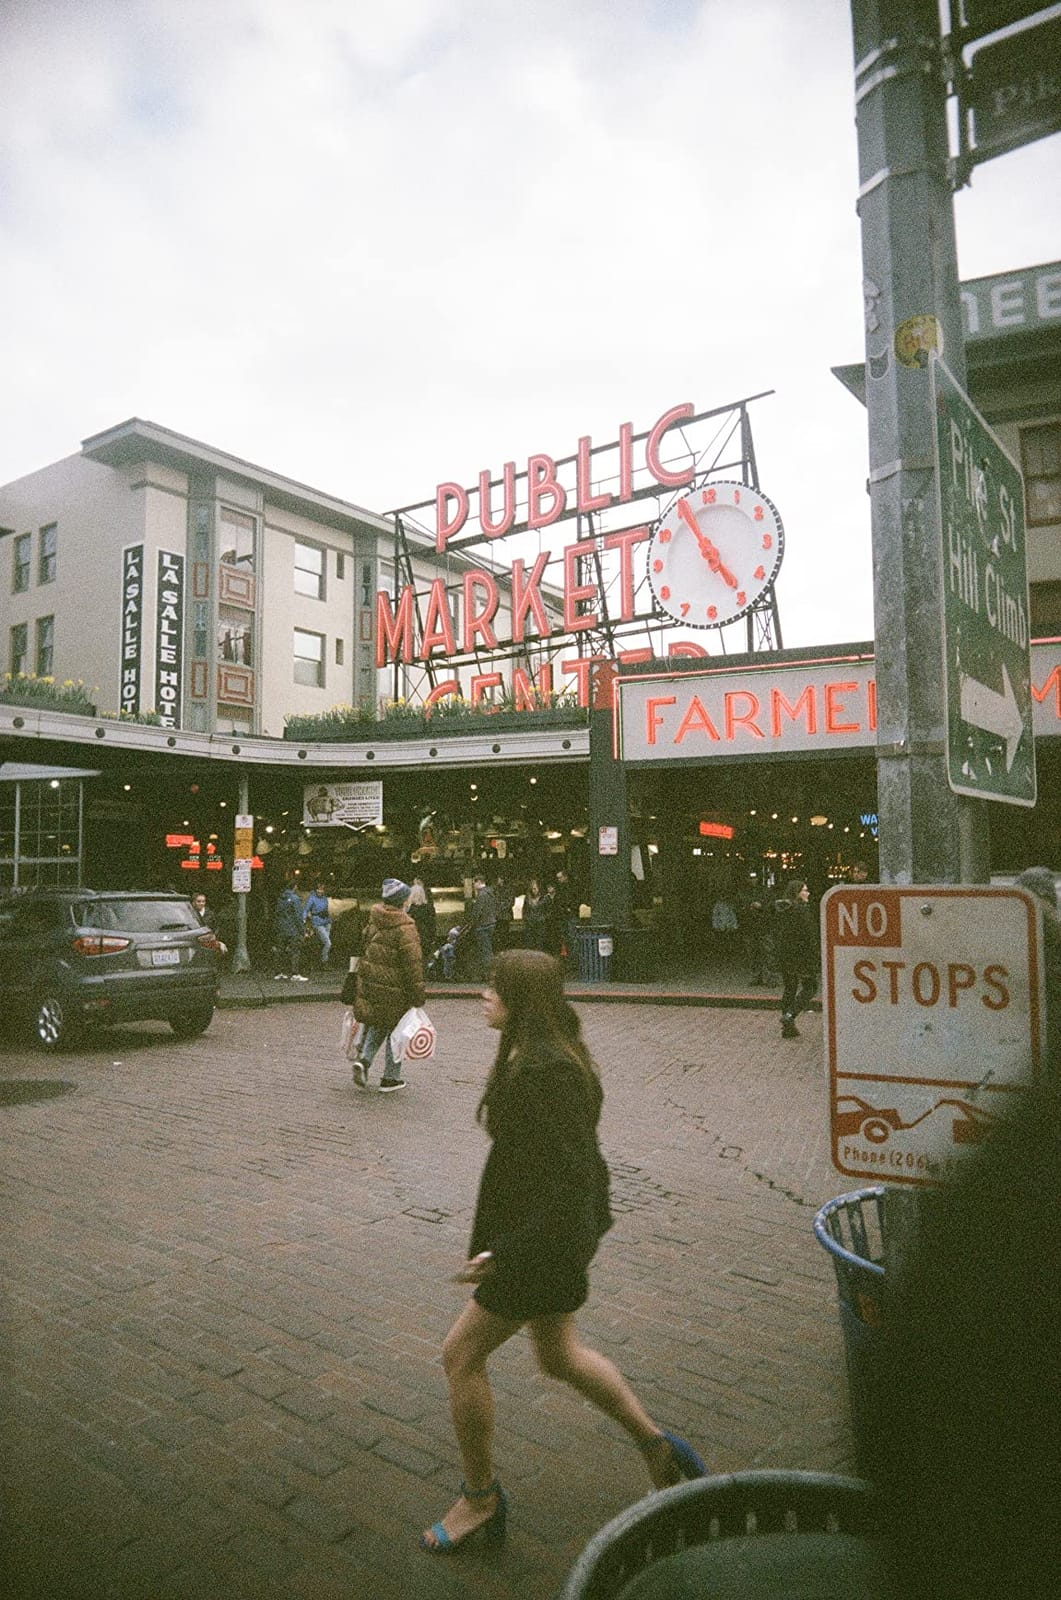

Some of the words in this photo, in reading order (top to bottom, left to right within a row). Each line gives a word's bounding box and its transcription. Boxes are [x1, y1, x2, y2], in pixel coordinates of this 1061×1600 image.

[435, 402, 695, 554] PUBLIC
[702, 488, 717, 504] 12
[734, 489, 740, 505] 1
[753, 505, 764, 521] 2
[999, 483, 1017, 553] St
[659, 528, 672, 544] 10
[762, 533, 773, 550] 3
[126, 551, 140, 580] LA
[162, 553, 179, 585] LA
[653, 559, 664, 574] 9
[753, 565, 766, 581] 4
[375, 525, 650, 669] MARKET
[660, 585, 671, 600] 8
[736, 591, 747, 607] 5
[948, 522, 979, 614] Hill
[985, 563, 1027, 651] Climb
[124, 583, 140, 660] SALLE
[680, 602, 691, 617] 7
[706, 604, 718, 620] 6
[160, 590, 178, 664] SALLE
[425, 640, 710, 722] CENT
[646, 680, 877, 745] FARME
[838, 902, 888, 938] NO
[852, 960, 1011, 1011] STOPS
